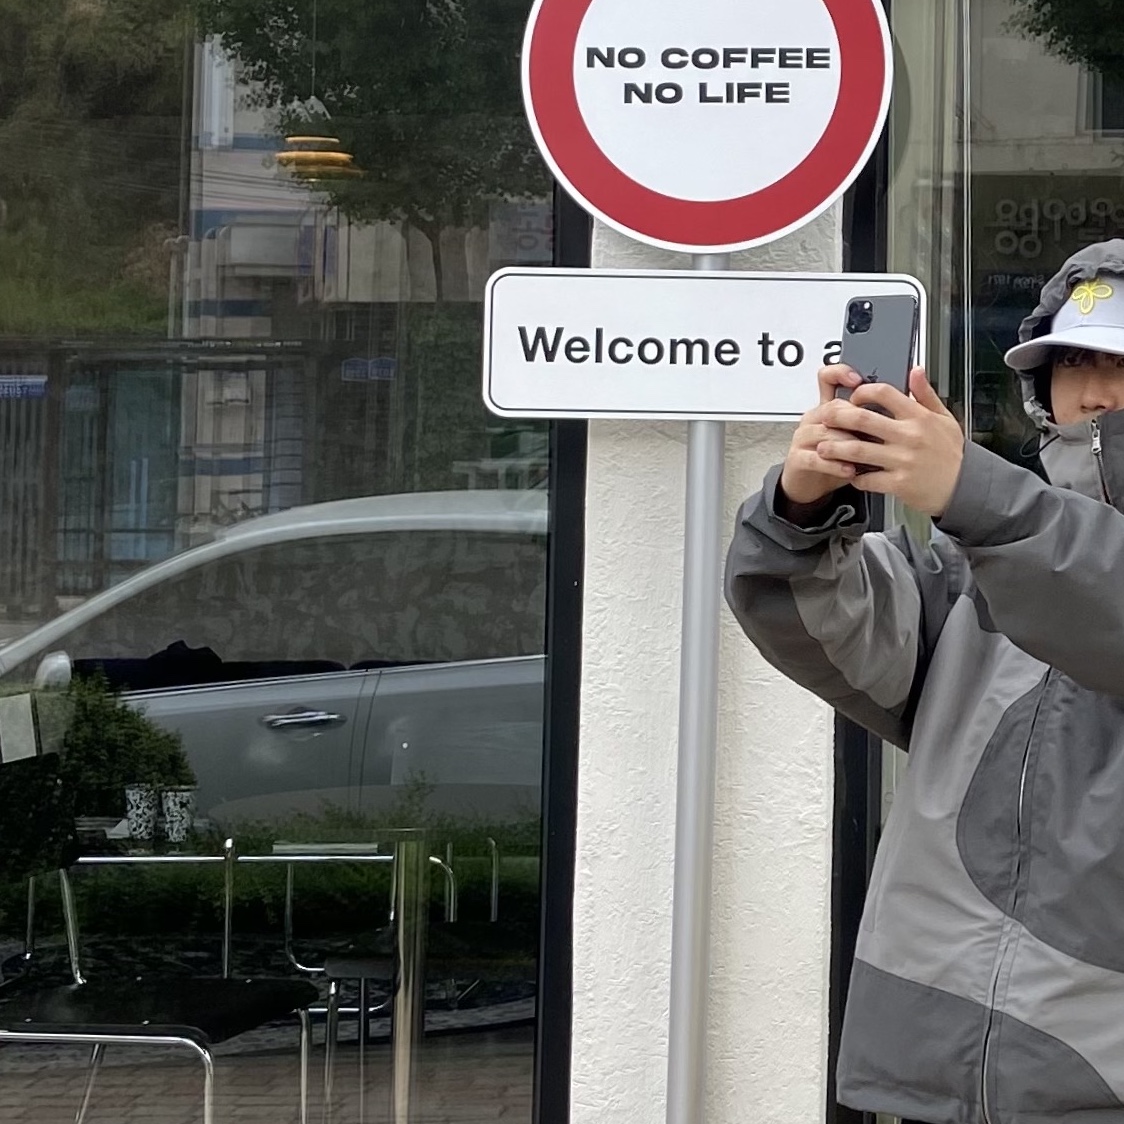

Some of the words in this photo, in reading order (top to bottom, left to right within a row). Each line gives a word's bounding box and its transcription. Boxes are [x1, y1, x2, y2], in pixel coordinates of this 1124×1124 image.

[586, 46, 647, 69] NO
[660, 47, 831, 70] COFFEE
[623, 81, 684, 104] NO
[698, 82, 791, 104] LIFE
[517, 325, 741, 366] Welcome
[757, 331, 804, 367] to
